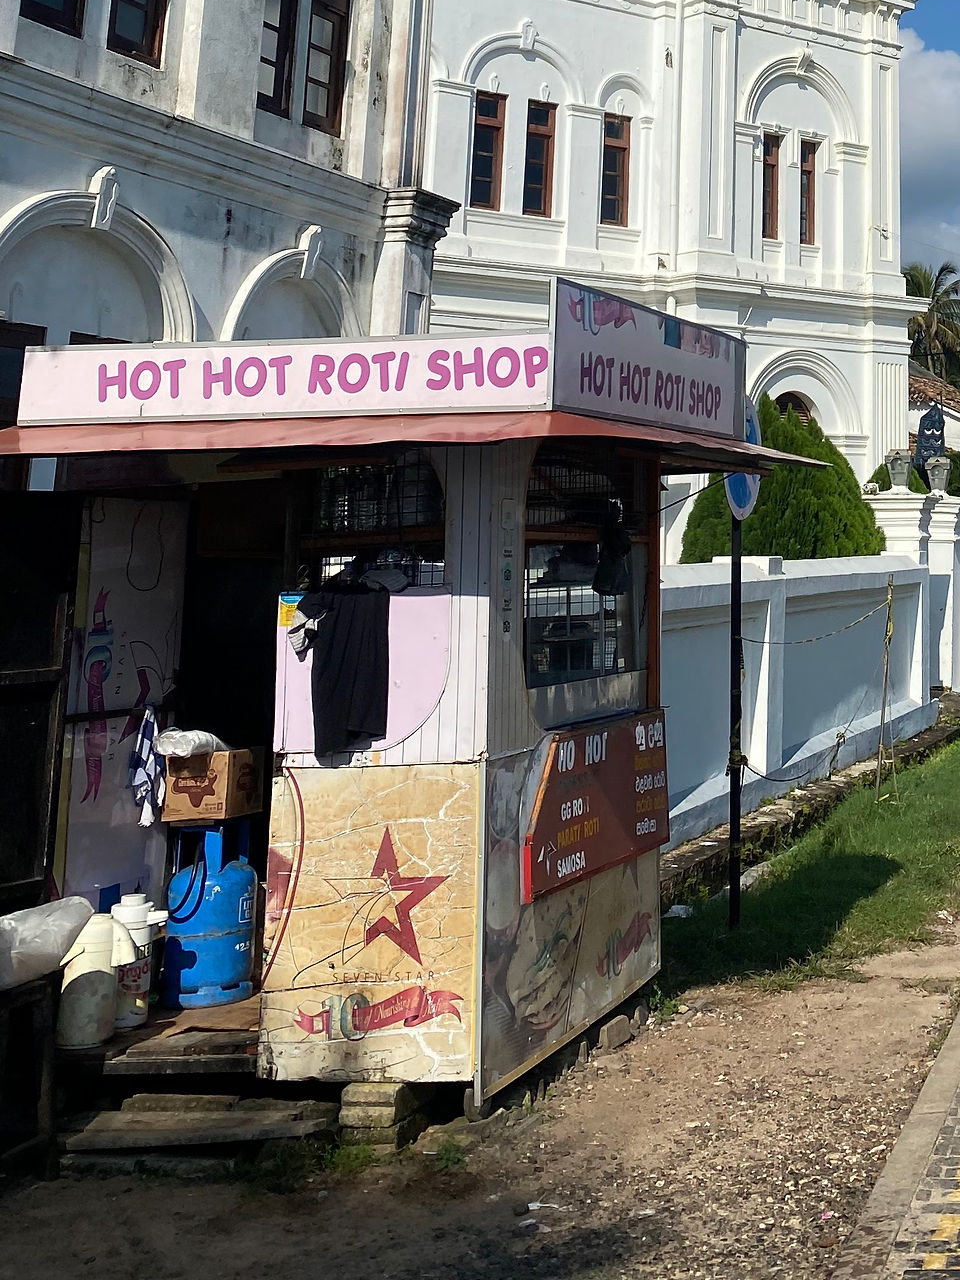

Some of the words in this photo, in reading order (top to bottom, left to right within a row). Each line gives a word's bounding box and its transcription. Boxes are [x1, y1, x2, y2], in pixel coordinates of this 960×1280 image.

[98, 358, 187, 403] HOT
[202, 354, 293, 400] HOT
[308, 351, 410, 395] ROTI
[425, 346, 548, 391] SHOP
[580, 351, 615, 398] HOT
[619, 361, 651, 406] HOT
[654, 369, 686, 413] ROTI
[688, 378, 722, 421] SHOP
[556, 851, 586, 878] SAMOSA
[332, 972, 383, 983] SEVEN
[394, 971, 435, 982] STAR
